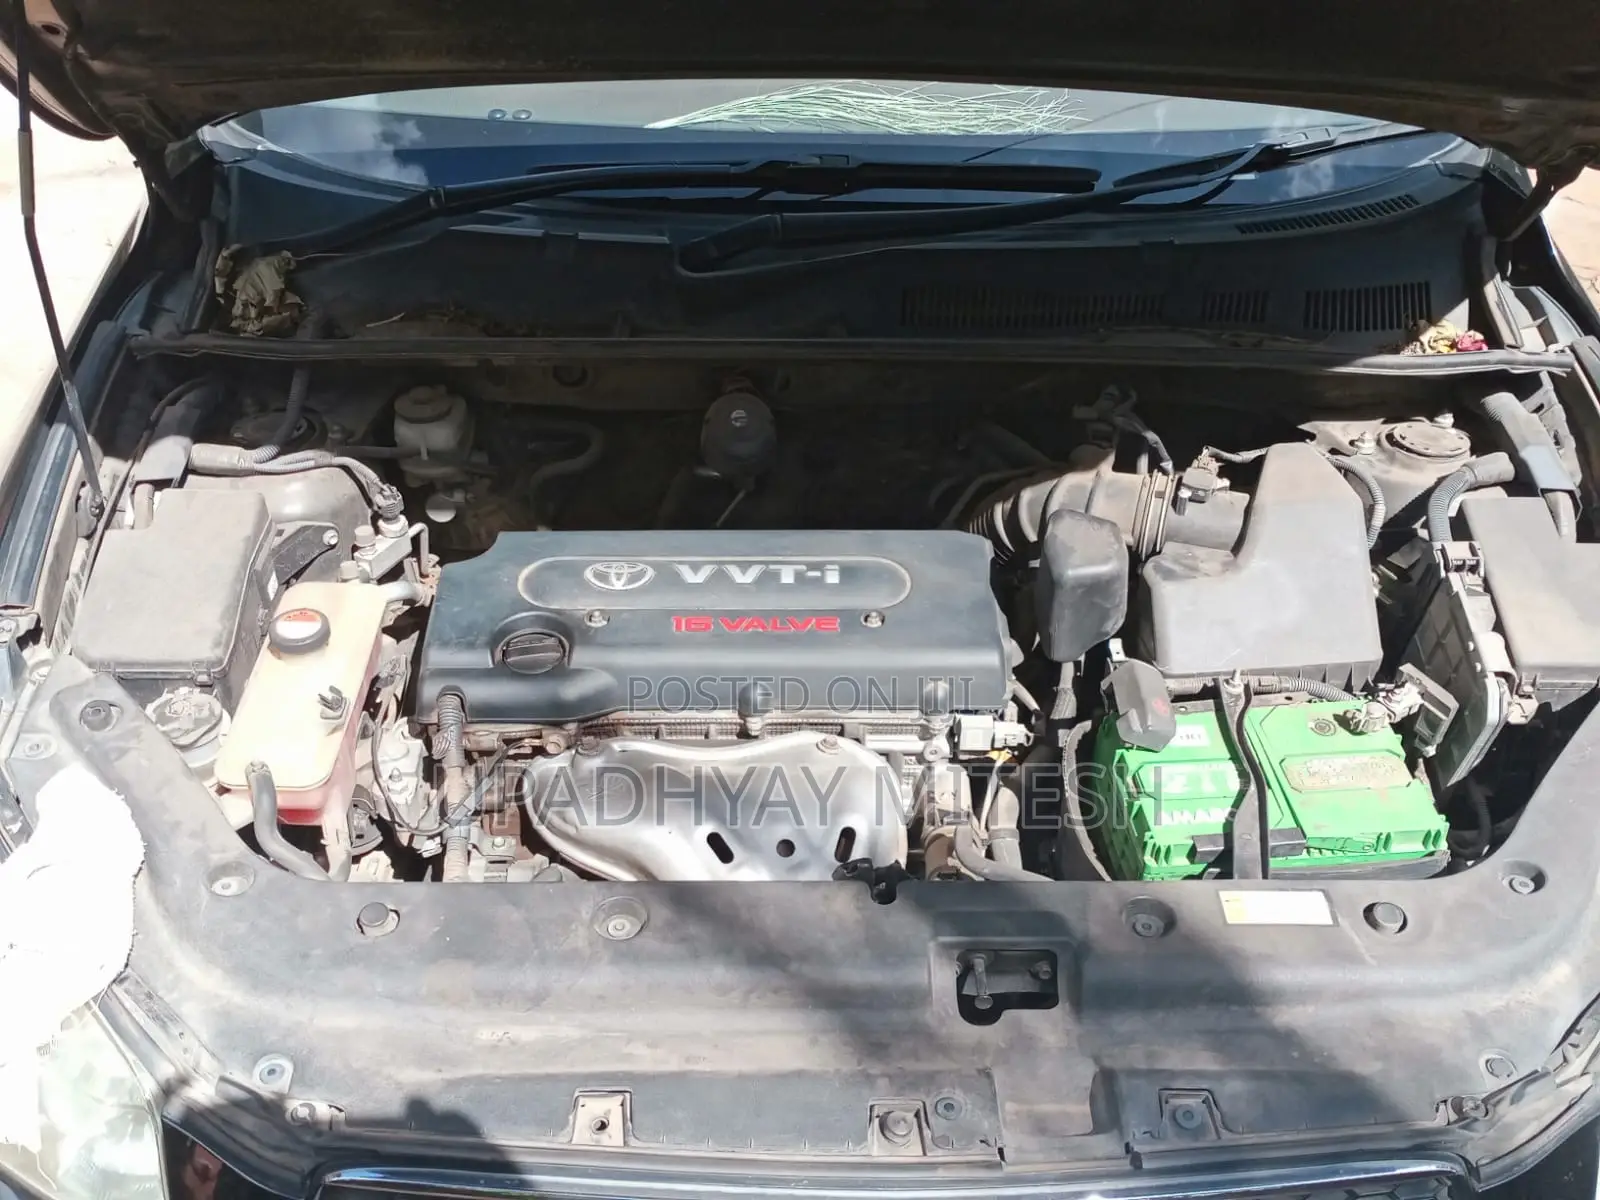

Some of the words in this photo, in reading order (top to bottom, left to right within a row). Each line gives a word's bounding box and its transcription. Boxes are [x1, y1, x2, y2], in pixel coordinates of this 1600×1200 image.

[673, 563, 840, 584] VVT-i
[672, 615, 714, 633] 16
[718, 615, 841, 633] VALVE
